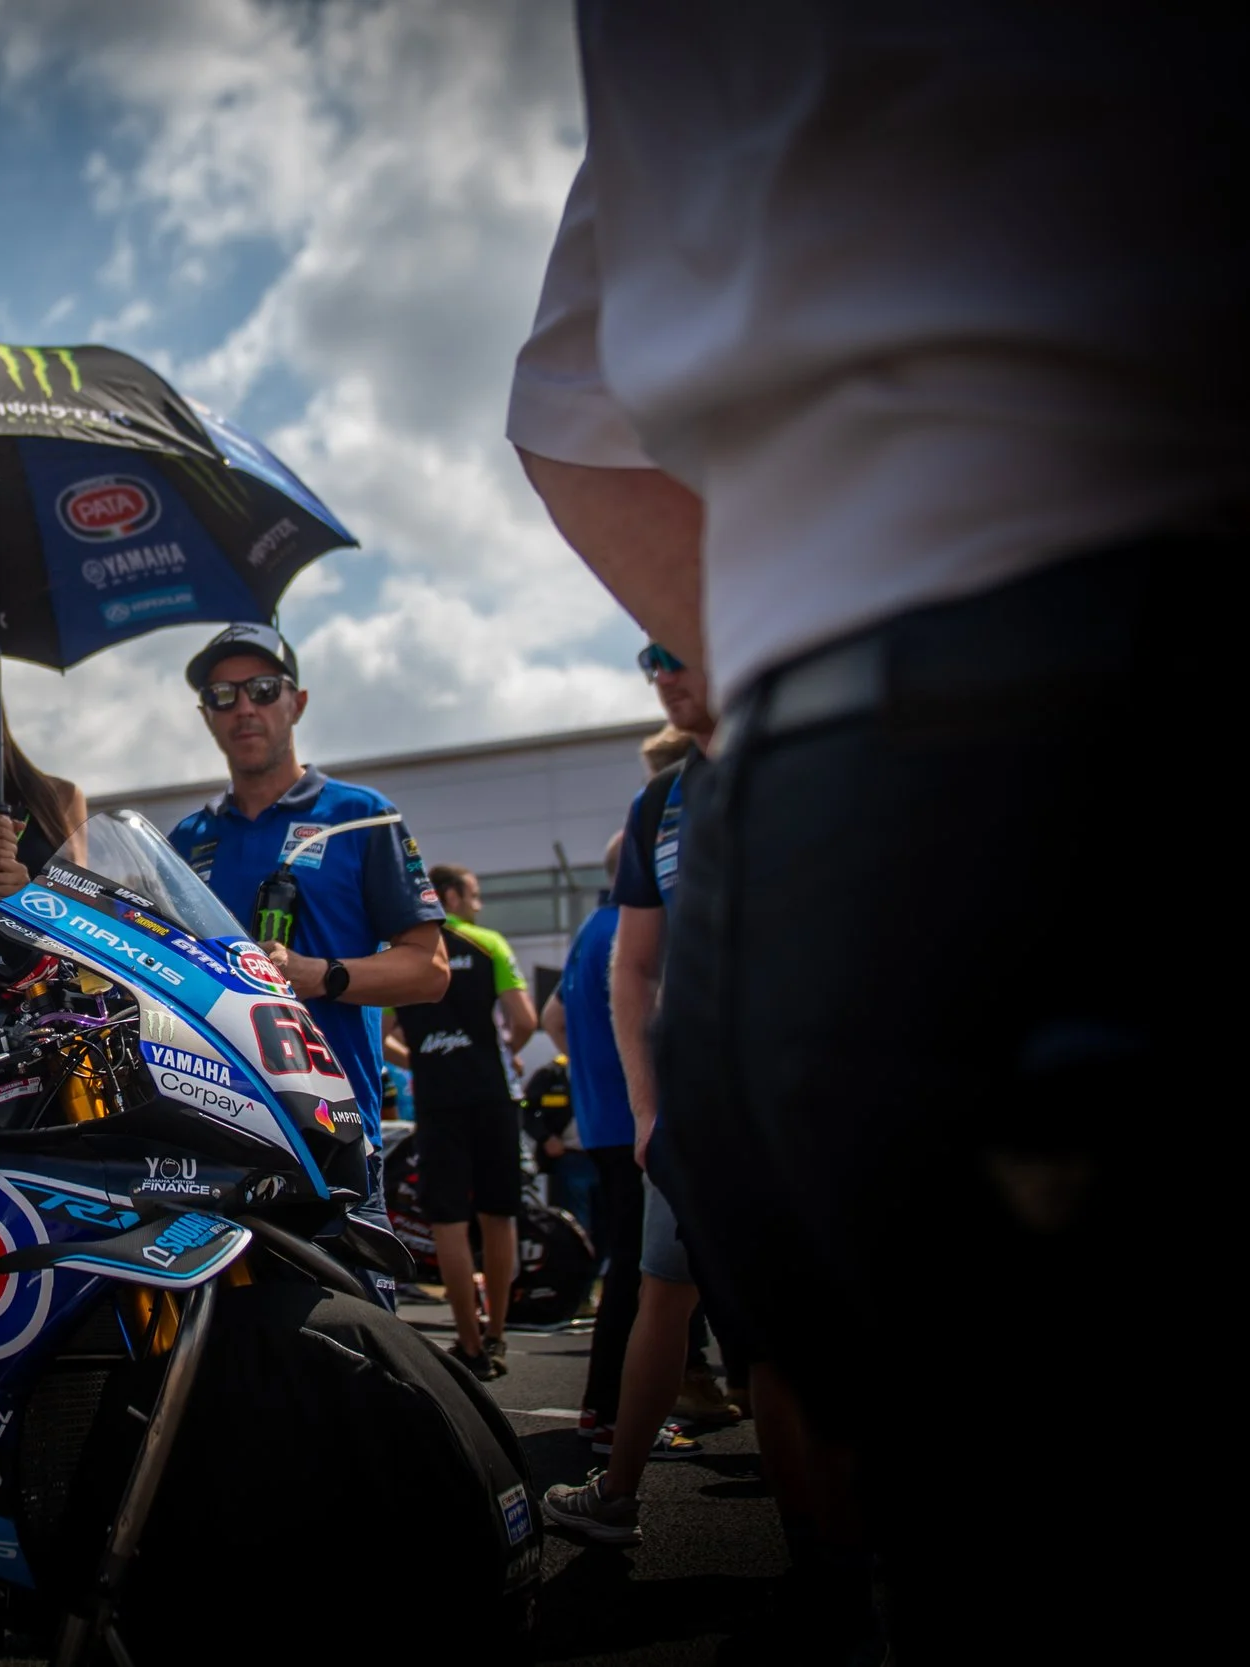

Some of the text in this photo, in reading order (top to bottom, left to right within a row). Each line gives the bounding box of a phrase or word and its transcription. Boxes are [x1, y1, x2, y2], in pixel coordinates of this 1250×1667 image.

[75, 494, 136, 523] PATA
[102, 541, 186, 577] YAMAHA
[47, 865, 105, 899] YAMALUBE
[69, 915, 186, 987] MAXUS
[170, 938, 228, 976] GYTR
[250, 1003, 345, 1080] 65
[419, 1027, 474, 1056] Ninja
[151, 1045, 232, 1087] YAMAHA
[160, 1072, 244, 1117] Corpay
[331, 1110, 362, 1125] AMPITO
[141, 1182, 211, 1196] FINANCE
